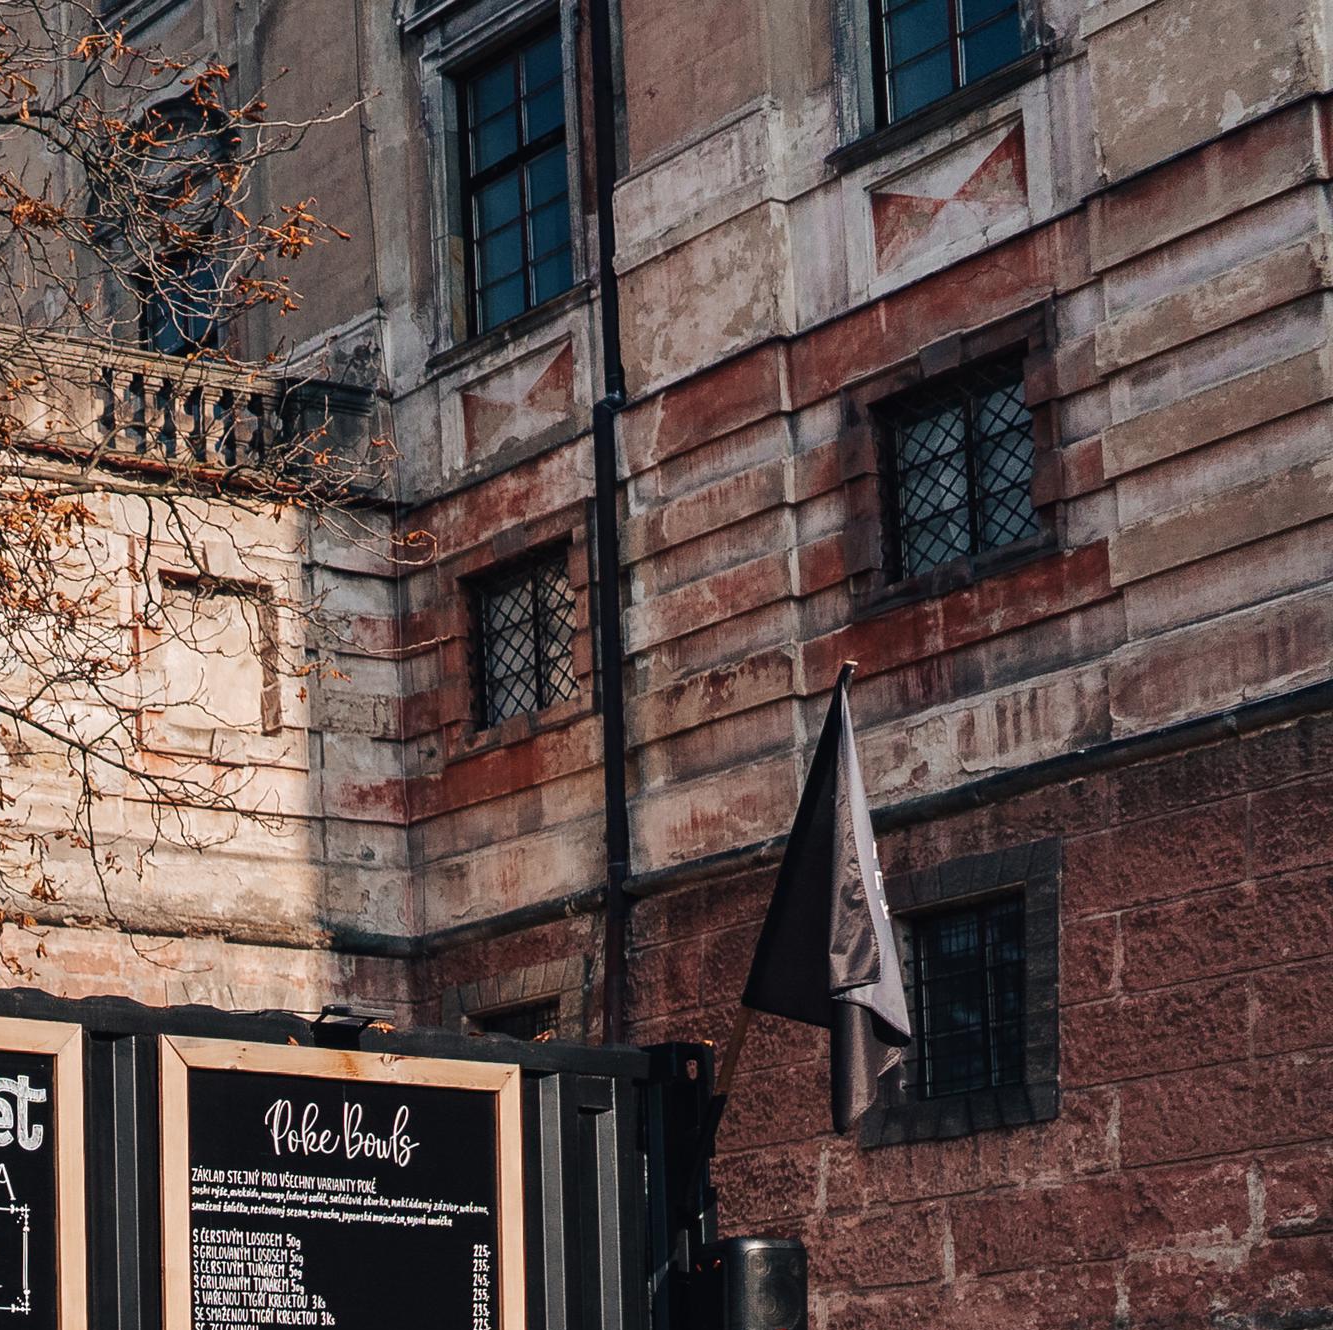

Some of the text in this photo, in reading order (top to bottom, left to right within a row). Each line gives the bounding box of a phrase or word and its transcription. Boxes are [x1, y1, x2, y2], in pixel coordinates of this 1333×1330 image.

[264, 1099, 420, 1168] Poke Bowls
[262, 1171, 279, 1188] PRO
[318, 1175, 356, 1194] VARIANTY
[246, 1231, 283, 1248] LOSOSEM
[285, 1233, 302, 1251] 50g
[252, 1248, 289, 1264] LOSOSEM
